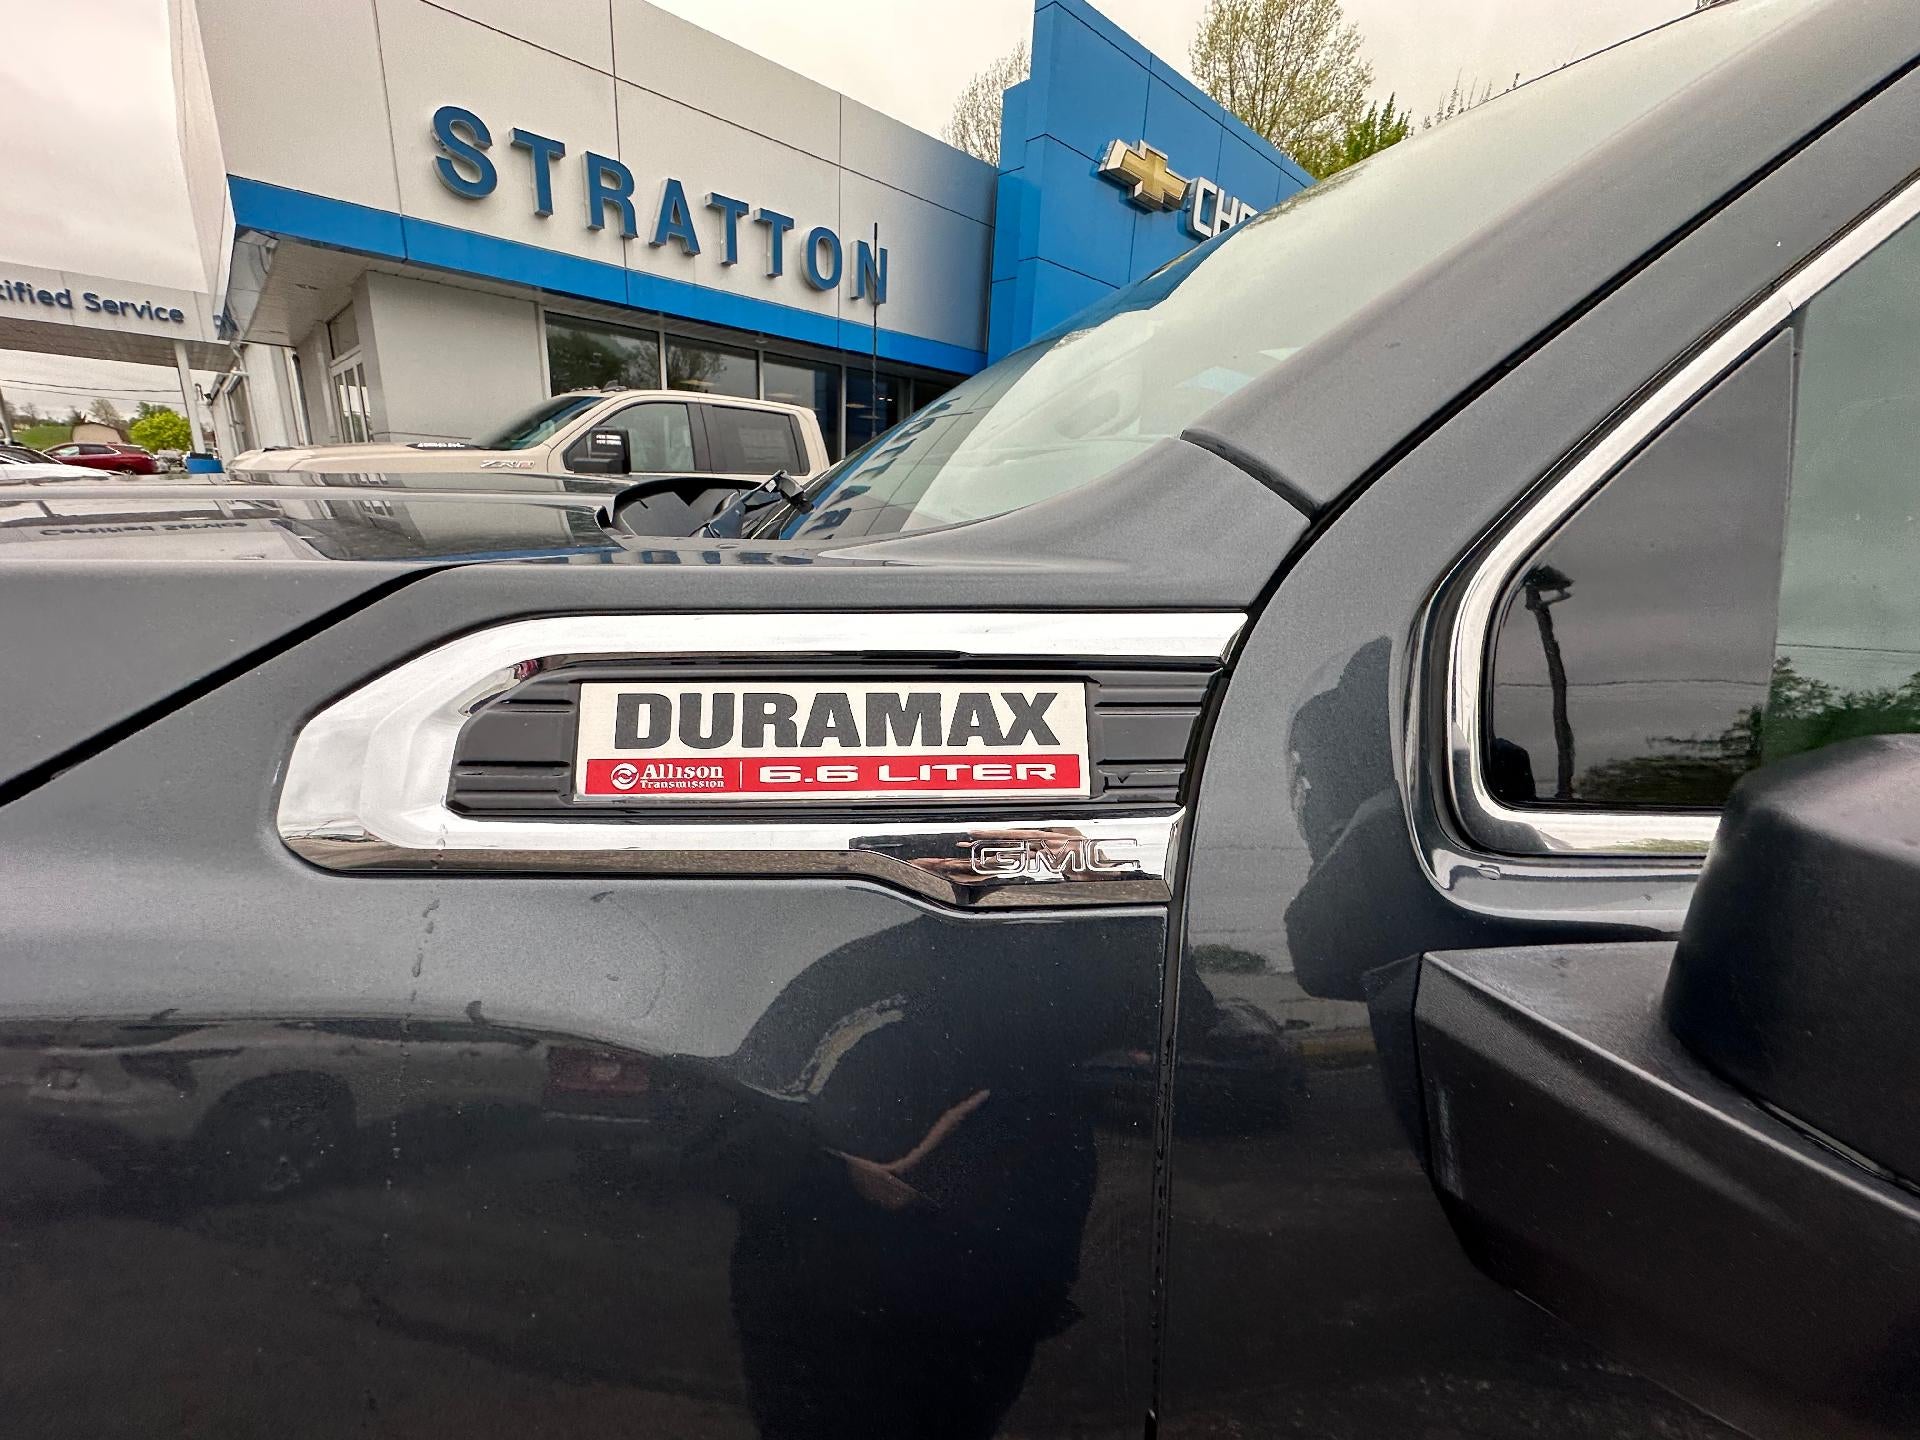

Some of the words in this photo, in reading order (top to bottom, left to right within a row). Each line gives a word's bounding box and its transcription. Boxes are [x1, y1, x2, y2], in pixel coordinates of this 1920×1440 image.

[432, 105, 888, 305] STRATTON
[82, 292, 185, 324] Service
[614, 692, 1061, 750] DURAMAX
[640, 779, 725, 789] Transmission
[641, 763, 724, 779] Allison
[759, 765, 859, 784] 6.6
[877, 763, 1057, 782] LITER
[971, 838, 1141, 875] GMC
